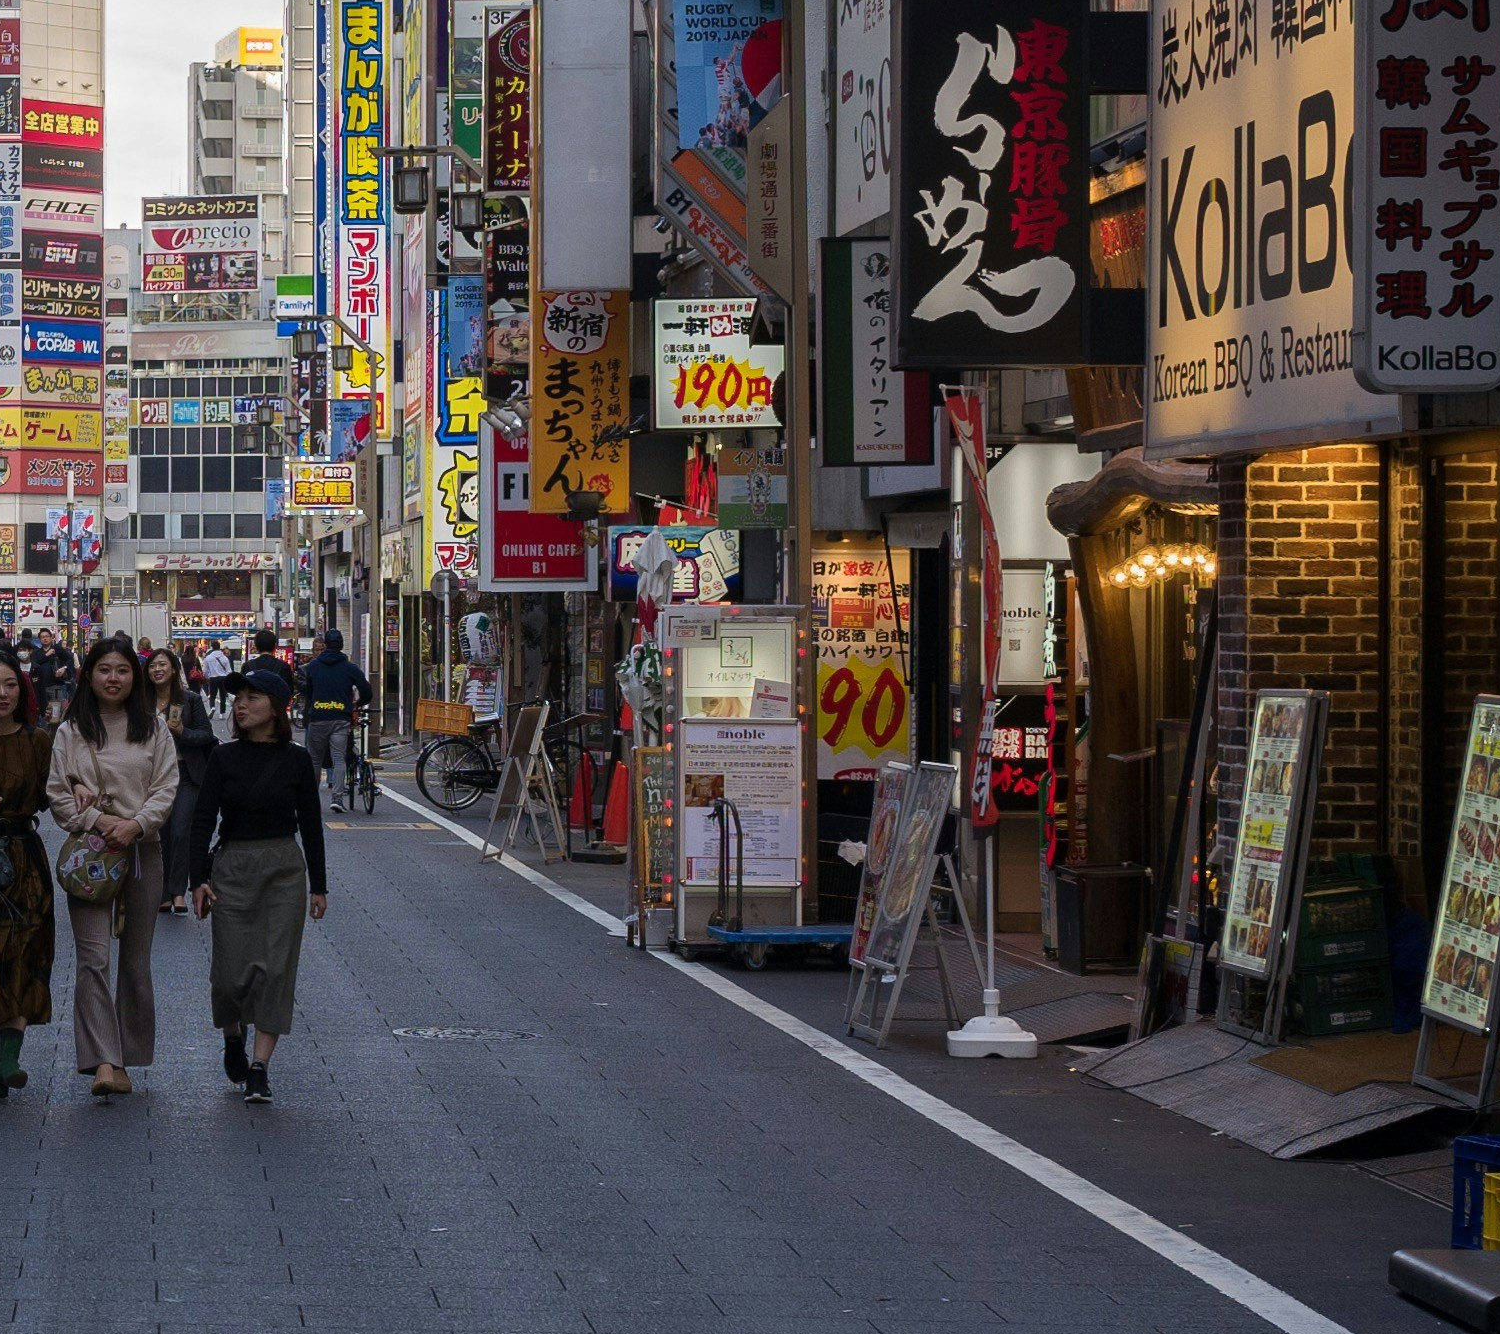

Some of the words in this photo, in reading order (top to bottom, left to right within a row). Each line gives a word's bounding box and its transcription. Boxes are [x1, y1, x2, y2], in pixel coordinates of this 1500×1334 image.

[684, 3, 734, 16] RUGBY
[684, 16, 737, 28] WORLD
[738, 16, 769, 28] CUP
[684, 30, 722, 43] 2019,
[723, 29, 769, 42] JAPAN
[24, 110, 99, 137] 全店営業中
[345, 3, 380, 219] まんが喫茶
[504, 75, 526, 178] カリーナ
[1009, 19, 1070, 253] 東京豚骨
[8, 145, 20, 195] カラオケ
[1375, 54, 1431, 321] 韓国料理
[1439, 54, 1500, 319] サムギョプサル
[25, 198, 100, 215] FACE
[145, 200, 257, 217] コミック&ネットカフェ
[758, 142, 781, 260] 劇場通り一番街
[0, 206, 14, 250] SEGA
[498, 243, 525, 255] BBQ
[0, 273, 14, 317] SEGA
[22, 279, 101, 300] ビリヤード&ダーツ
[347, 229, 378, 344] マンボー
[864, 295, 893, 439] 俺のイタリアン
[1153, 351, 1210, 404] Korean
[1214, 338, 1254, 392] BBQ
[1258, 347, 1275, 381] &
[1377, 345, 1498, 373] KollaBo
[25, 367, 99, 394] まんが喫茶
[673, 363, 773, 410] 190円
[25, 420, 72, 442] ゲーム
[501, 544, 548, 558] ONLINE
[531, 561, 548, 574] B1
[725, 729, 766, 740] noble
